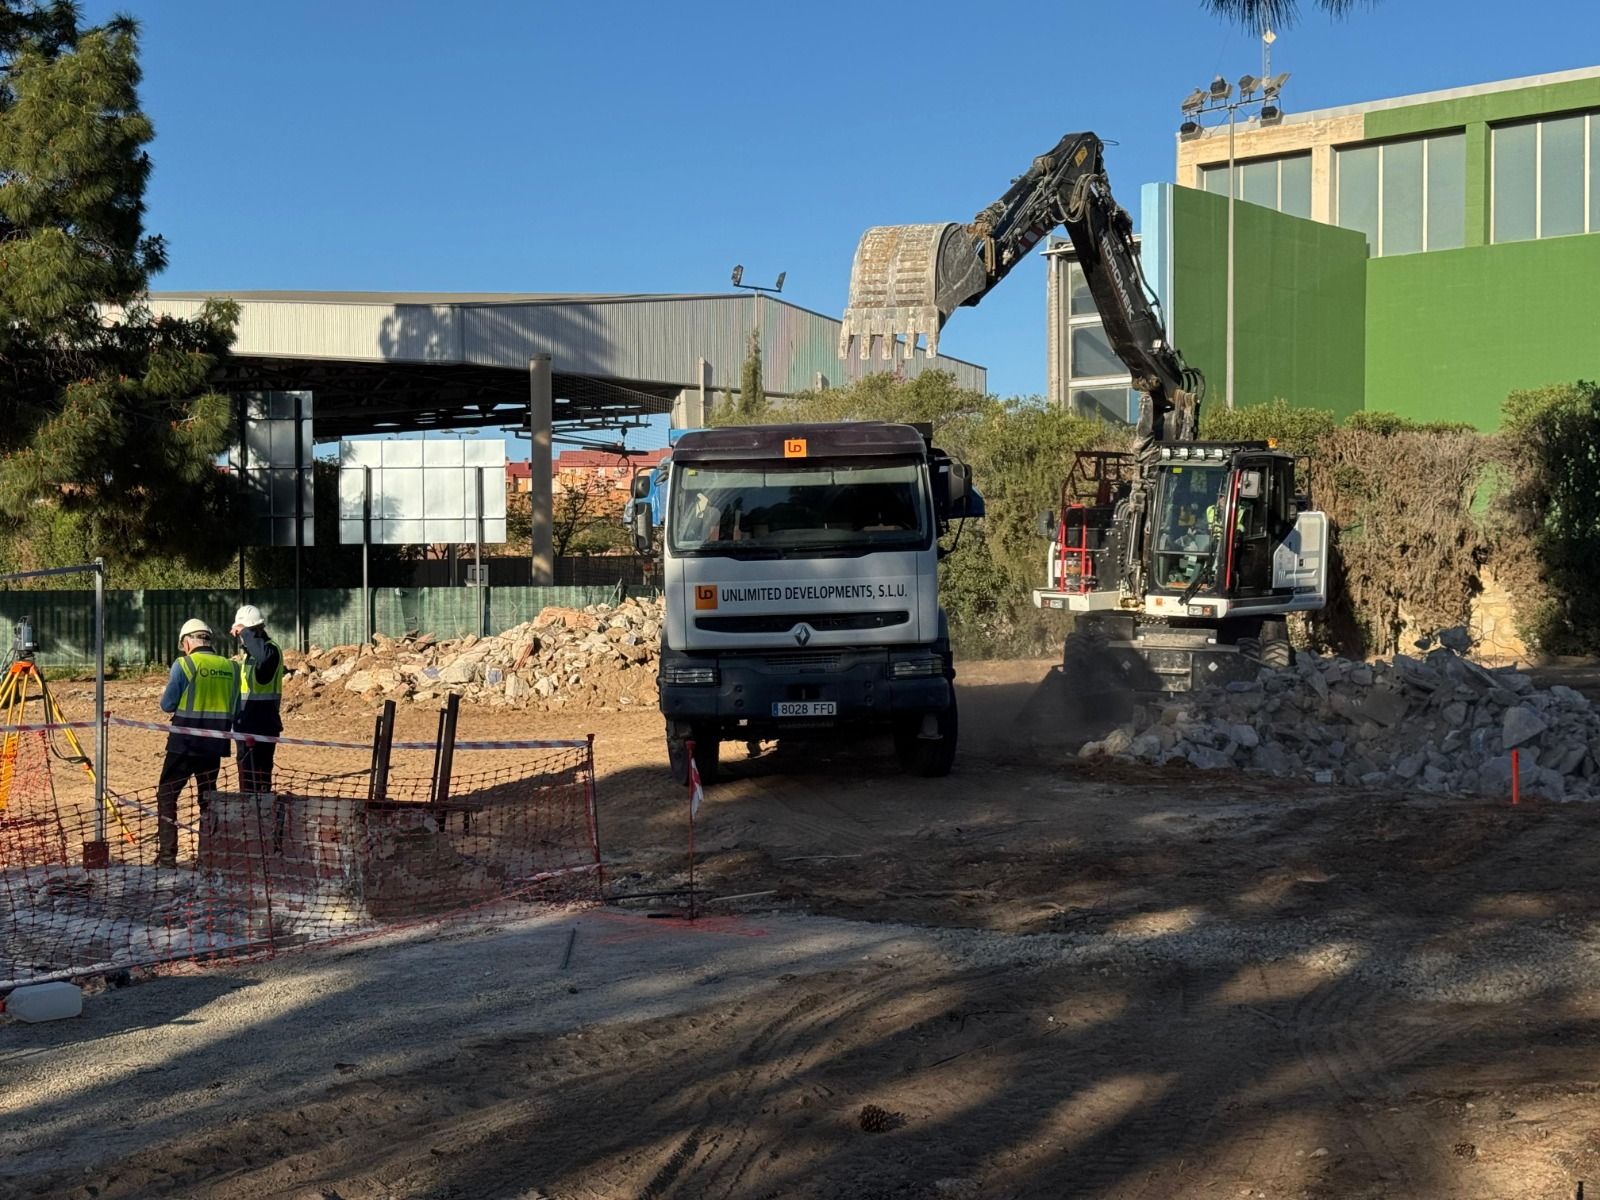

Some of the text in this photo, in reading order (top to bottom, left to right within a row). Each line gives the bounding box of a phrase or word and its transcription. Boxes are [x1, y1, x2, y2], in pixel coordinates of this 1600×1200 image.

[722, 583, 908, 602] UNLIMITED DEVELOPMENTS, S.L.U.
[781, 703, 834, 715] 8028 FFD
